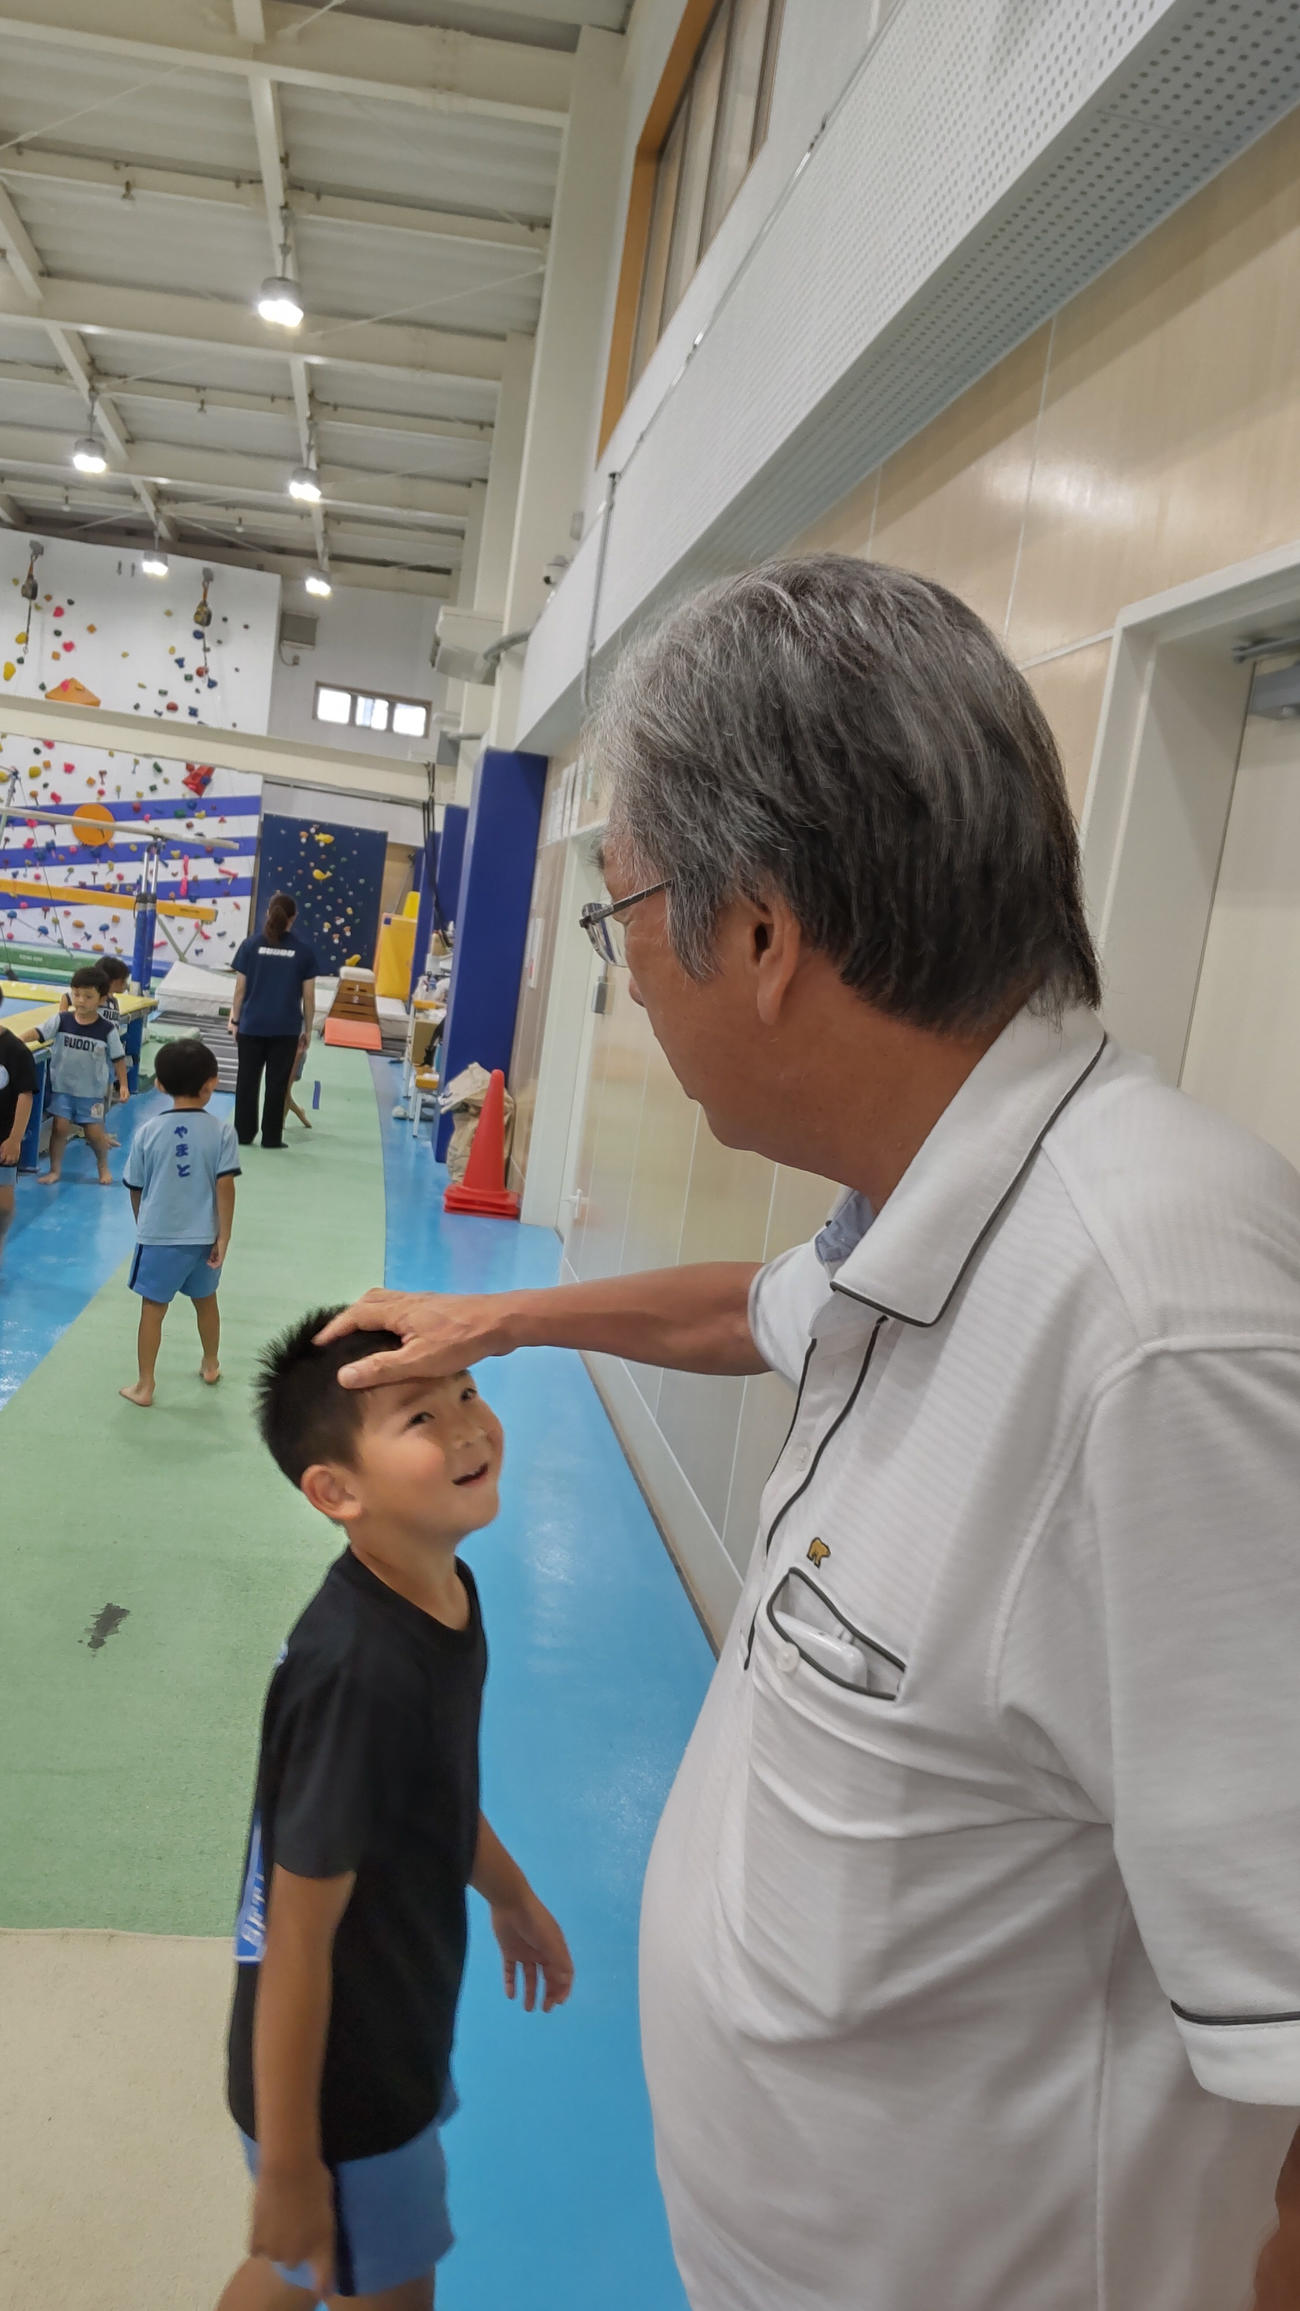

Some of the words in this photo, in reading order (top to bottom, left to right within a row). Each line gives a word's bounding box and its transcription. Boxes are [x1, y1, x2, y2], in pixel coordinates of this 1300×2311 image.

[63, 1035, 98, 1052] BUDDY
[174, 1125, 191, 1178] やまと
